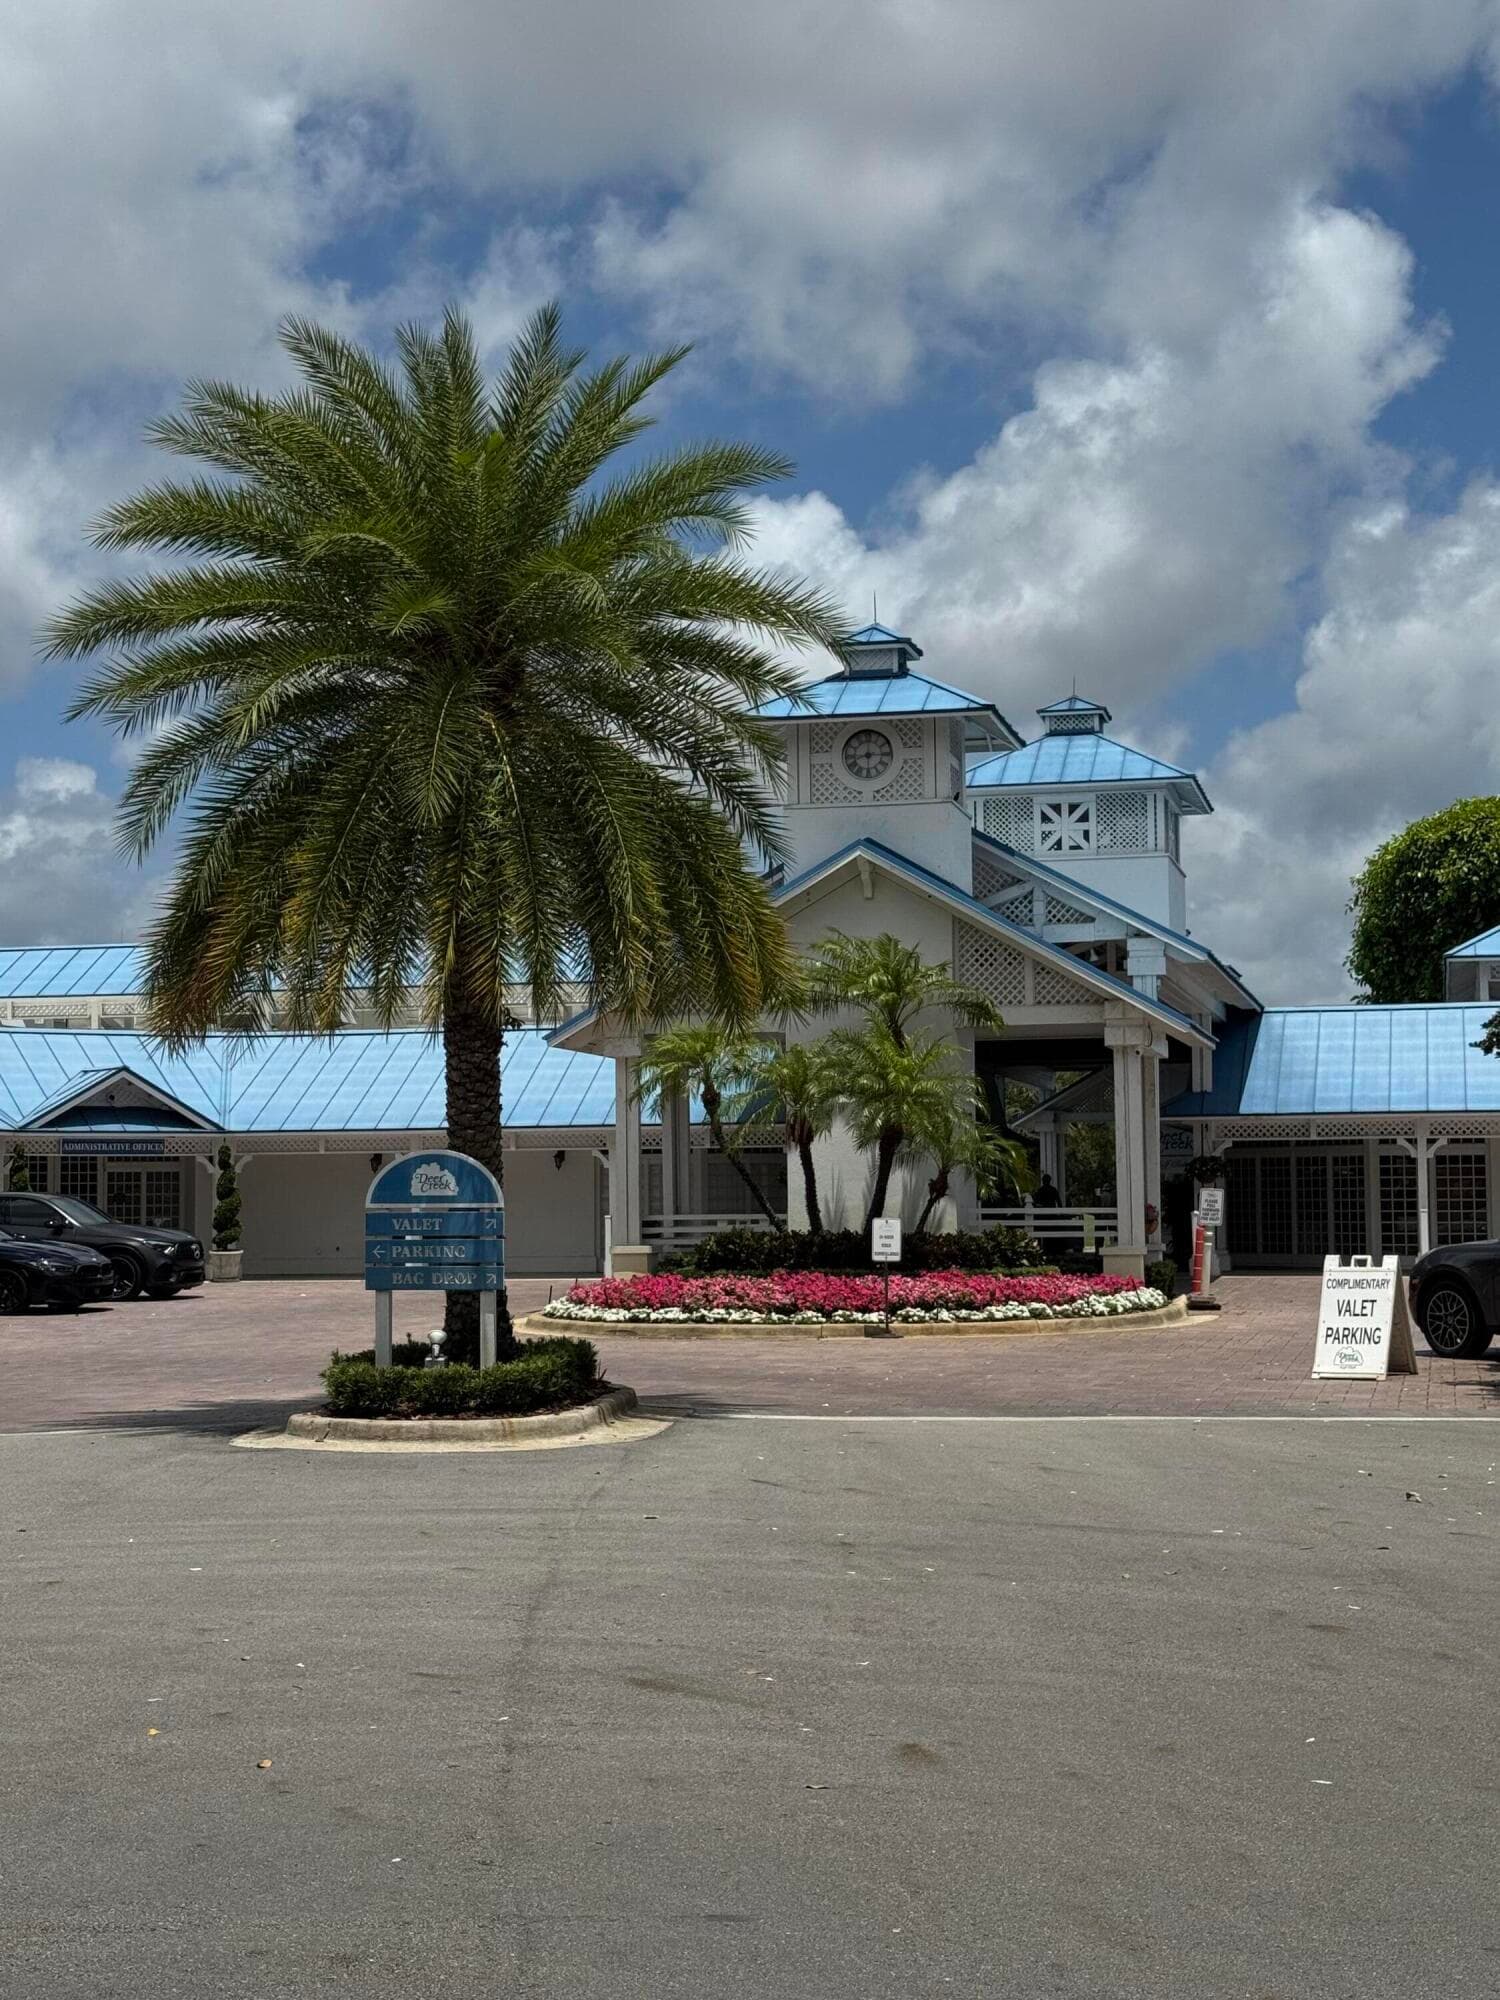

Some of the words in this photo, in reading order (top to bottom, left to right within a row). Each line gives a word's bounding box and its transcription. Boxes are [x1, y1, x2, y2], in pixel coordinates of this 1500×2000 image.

[63, 1142, 130, 1151] ADMINISTRATIVE
[132, 1142, 164, 1151] OFFICES
[1160, 1136, 1193, 1153] reek
[415, 1173, 447, 1184] Deer
[420, 1179, 455, 1193] Creek
[391, 1218, 443, 1231] VALET
[391, 1245, 466, 1258] PARKING
[391, 1272, 425, 1285] BAG
[431, 1272, 477, 1285] DROP
[1326, 1278, 1391, 1290] COMPLIMENTARY
[1336, 1299, 1377, 1317] VALET
[1324, 1327, 1382, 1345] PARKING
